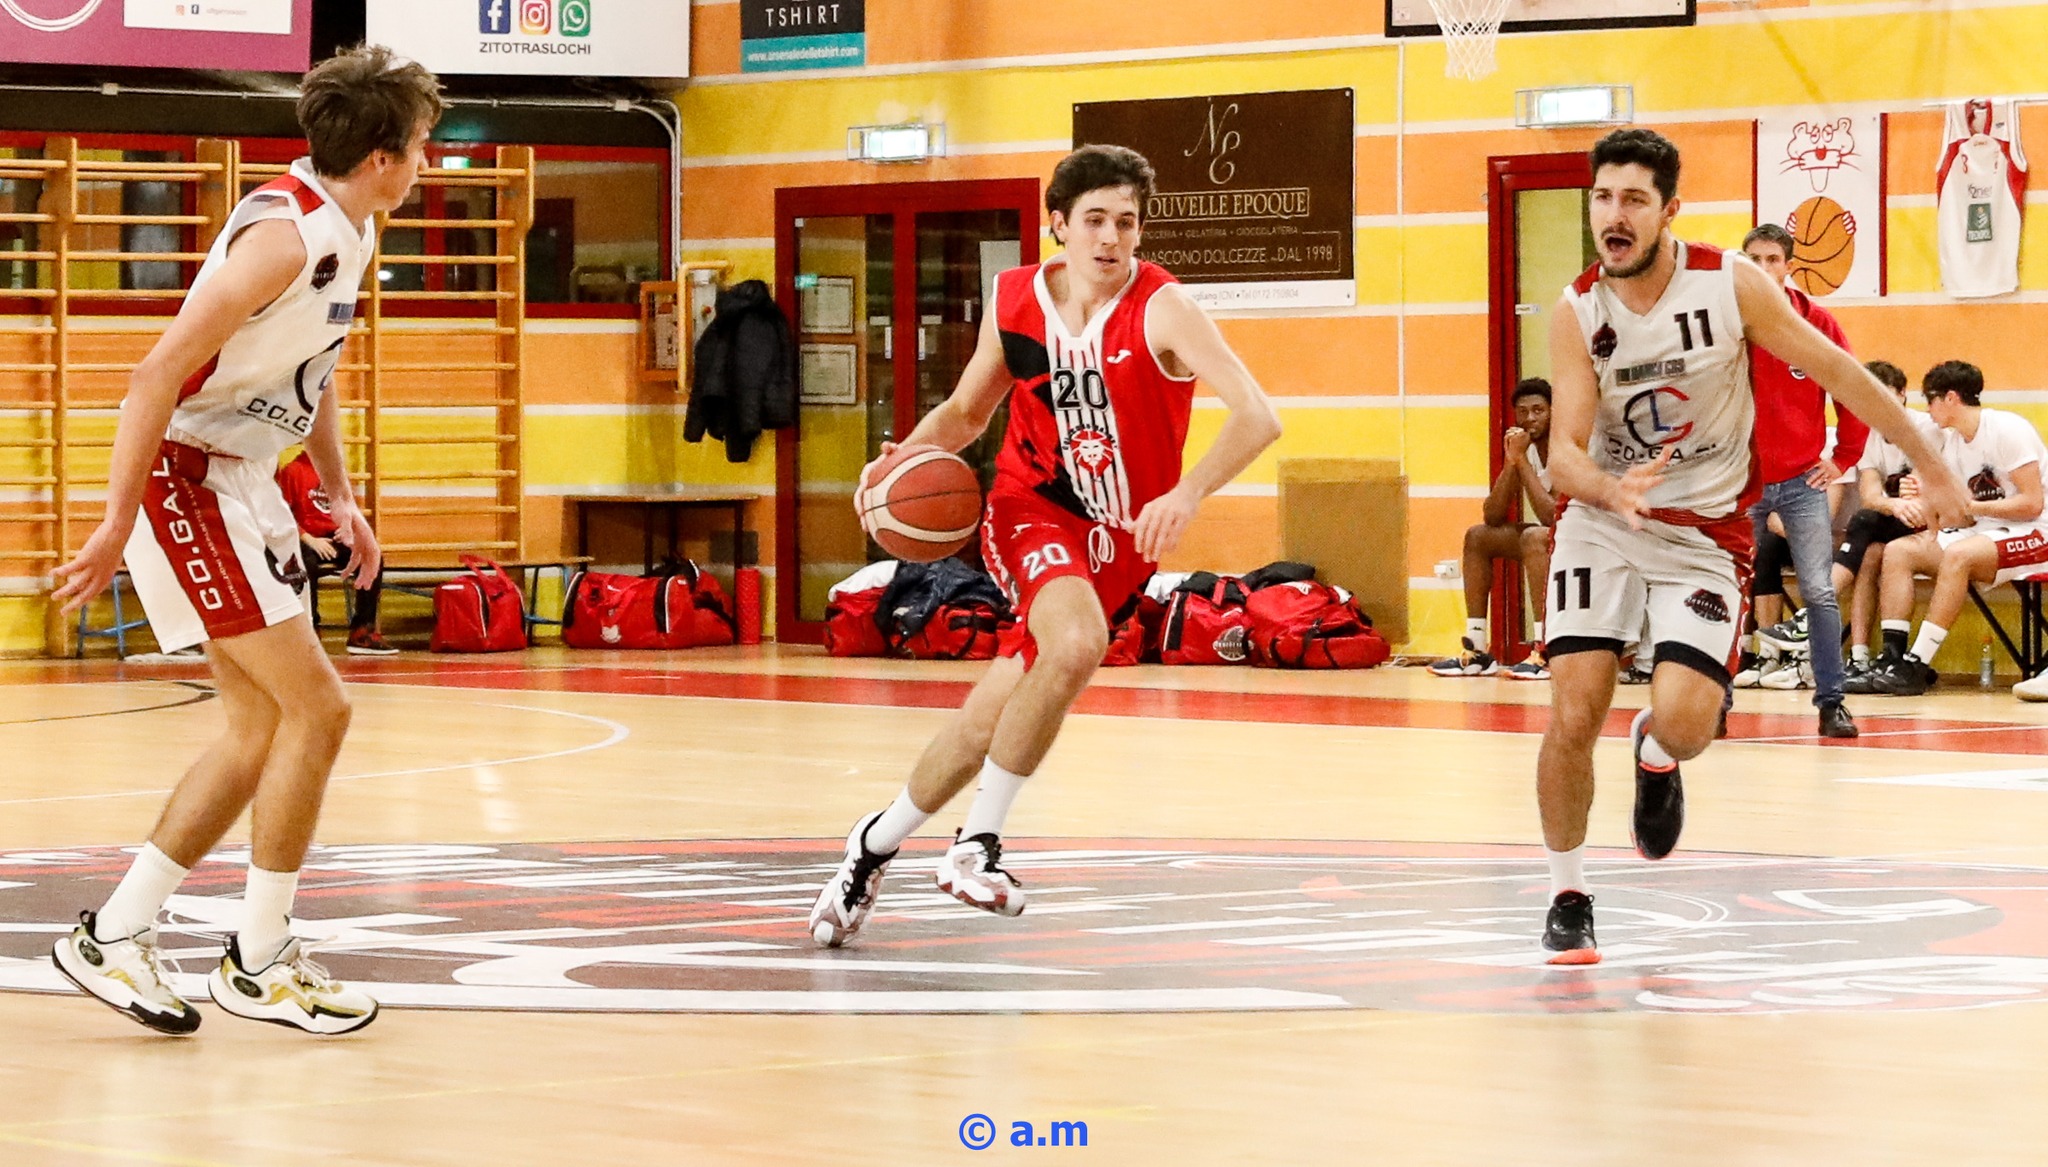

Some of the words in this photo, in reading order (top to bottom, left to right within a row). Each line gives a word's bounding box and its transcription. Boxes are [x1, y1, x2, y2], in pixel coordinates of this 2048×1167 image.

[765, 4, 840, 27] TSHIRT
[480, 42, 591, 55] ZITOTRASLOCHI
[1147, 194, 1229, 218] OUVELLE
[1233, 191, 1307, 219] EPOQUE
[1203, 249, 1267, 264] DOLCEZZE
[1306, 245, 1333, 261] 1998
[1674, 309, 1714, 351] 11
[1052, 366, 1110, 412] 20
[1022, 543, 1073, 582] 20
[1554, 567, 1591, 612] 11
